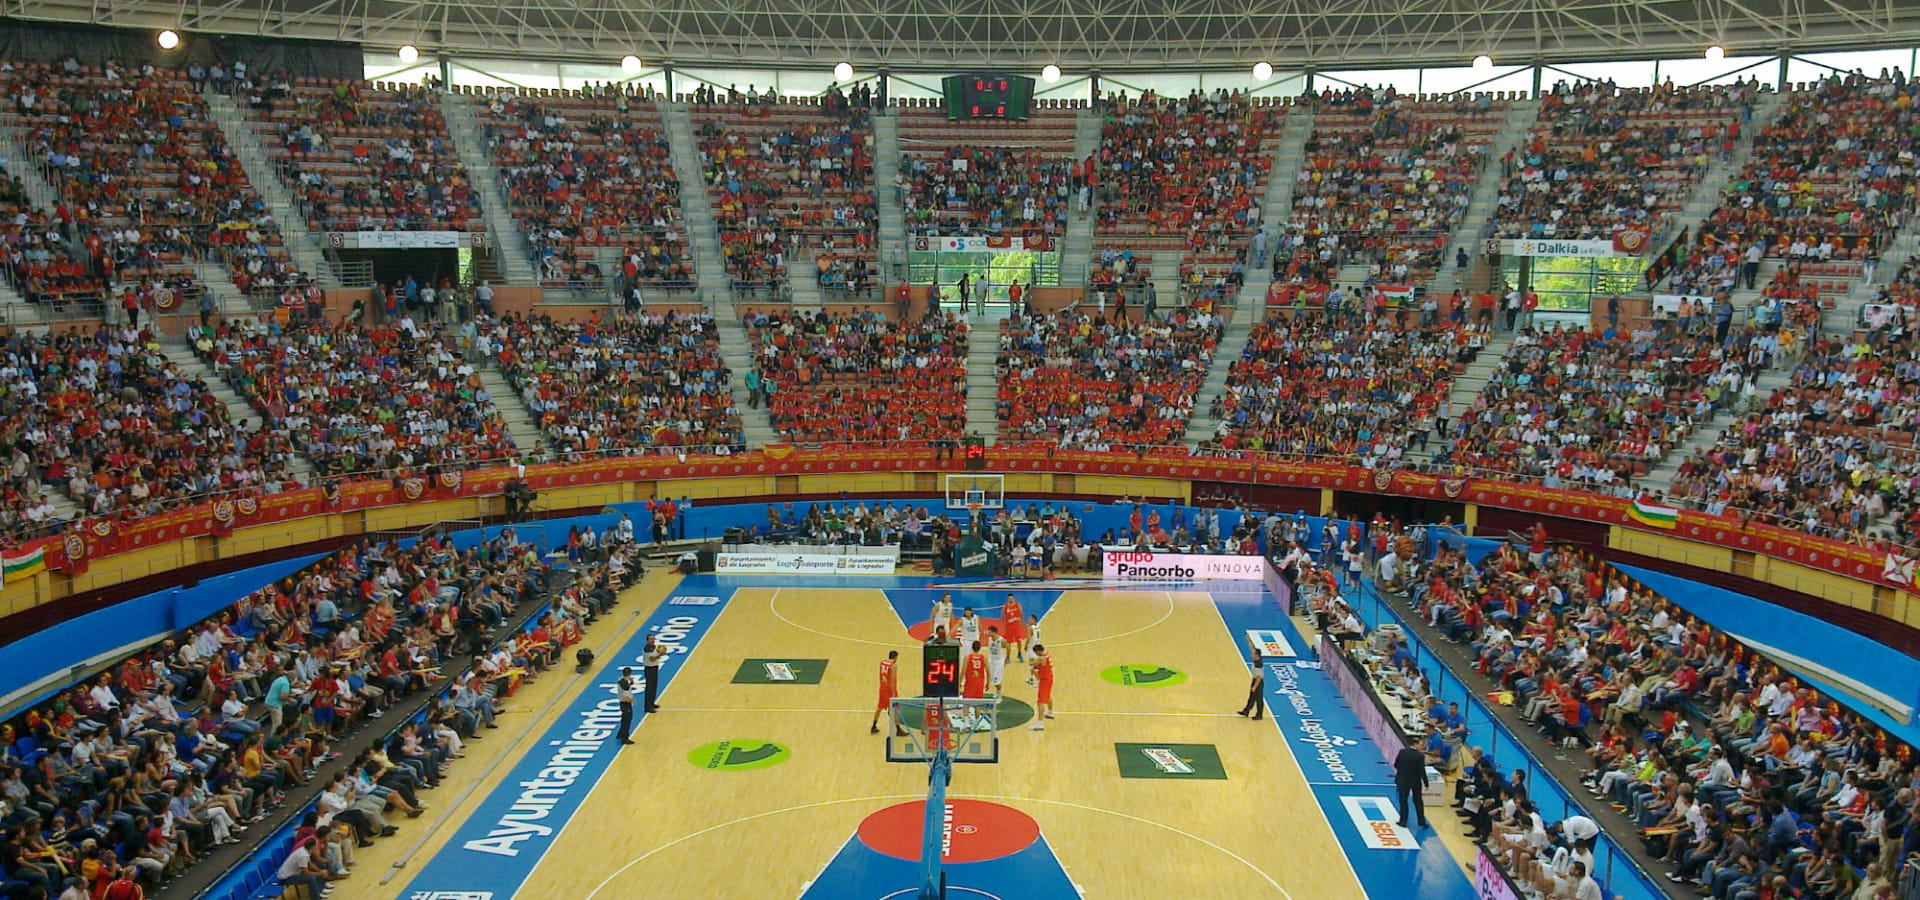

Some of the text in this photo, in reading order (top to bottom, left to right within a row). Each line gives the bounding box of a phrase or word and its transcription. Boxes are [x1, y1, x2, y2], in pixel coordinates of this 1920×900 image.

[1537, 243, 1578, 254] Dalkia
[967, 446, 983, 458] 24
[1107, 552, 1153, 566] grupo
[1117, 564, 1195, 577] Pancorbo
[1207, 563, 1262, 574] INNOVA
[928, 662, 955, 684] 24
[463, 698, 624, 857] Ayuntamiento
[1369, 821, 1402, 847] SEUR
